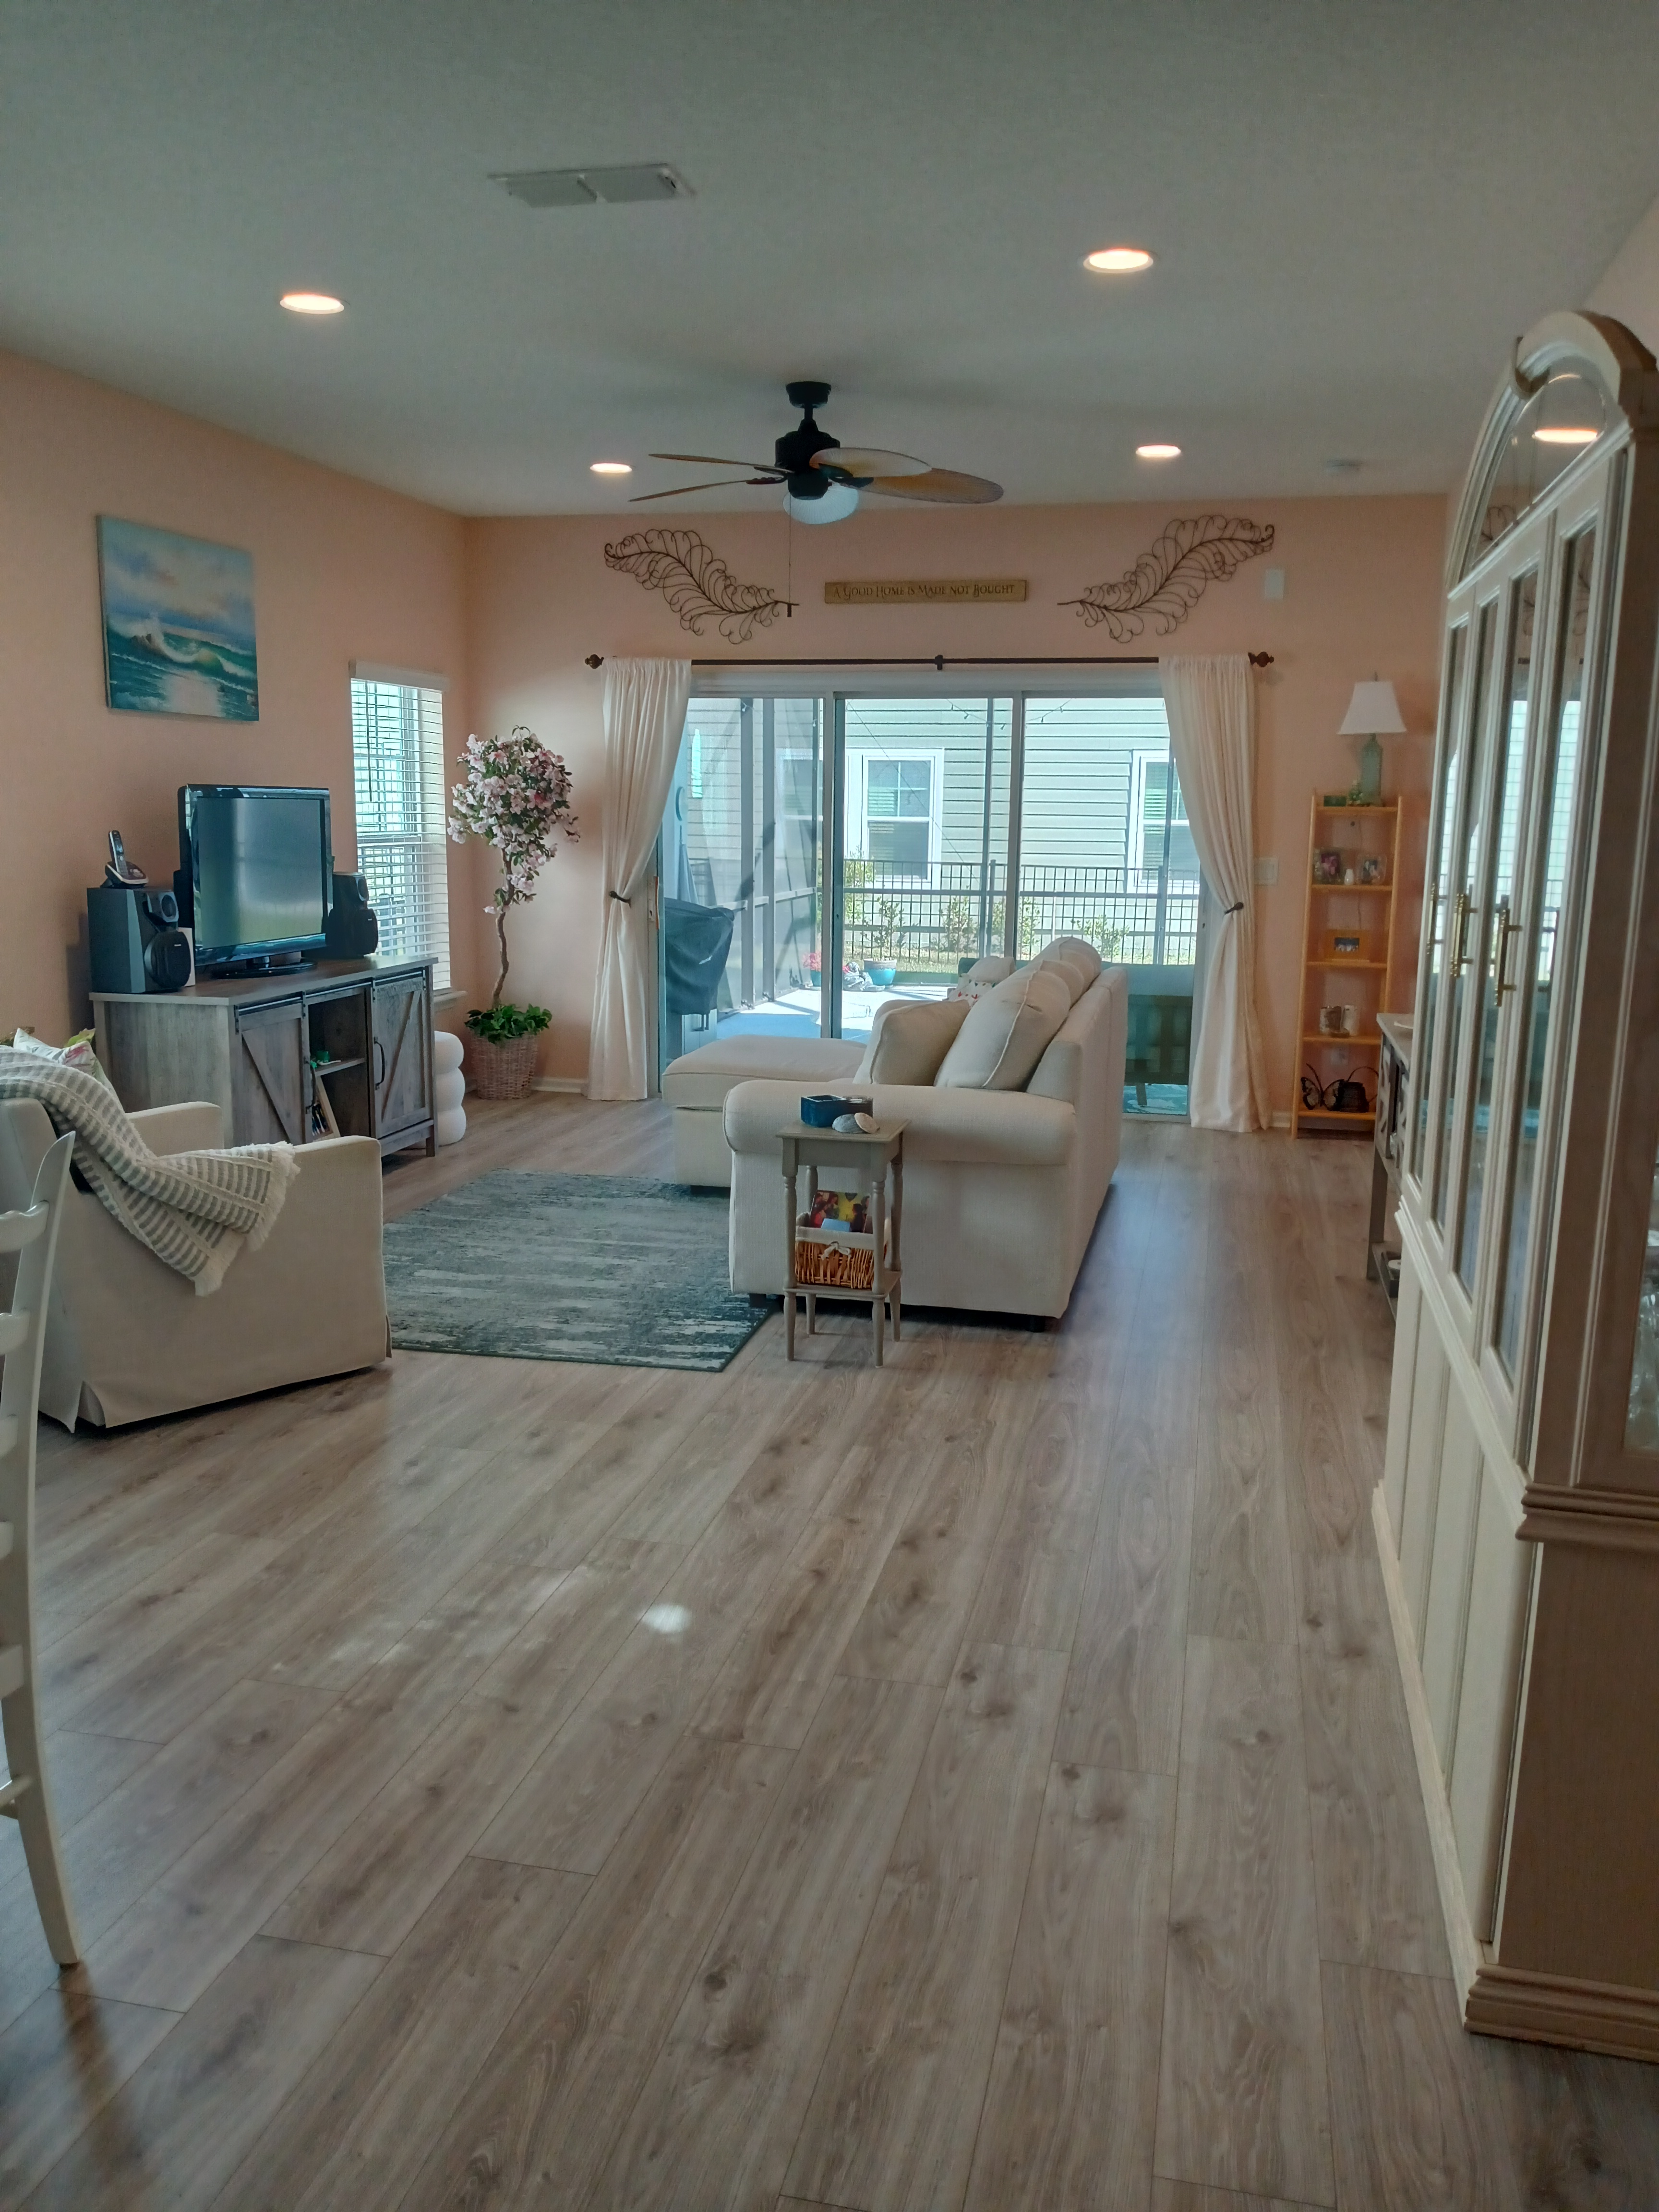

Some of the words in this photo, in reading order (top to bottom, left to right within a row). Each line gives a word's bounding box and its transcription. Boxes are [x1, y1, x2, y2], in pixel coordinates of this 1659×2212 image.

[834, 586, 841, 599] A
[842, 586, 873, 600] GOOD
[876, 585, 904, 599] HOME
[918, 584, 945, 599] MADE
[950, 585, 970, 596] NOT
[973, 584, 1015, 598] BOUGHT
